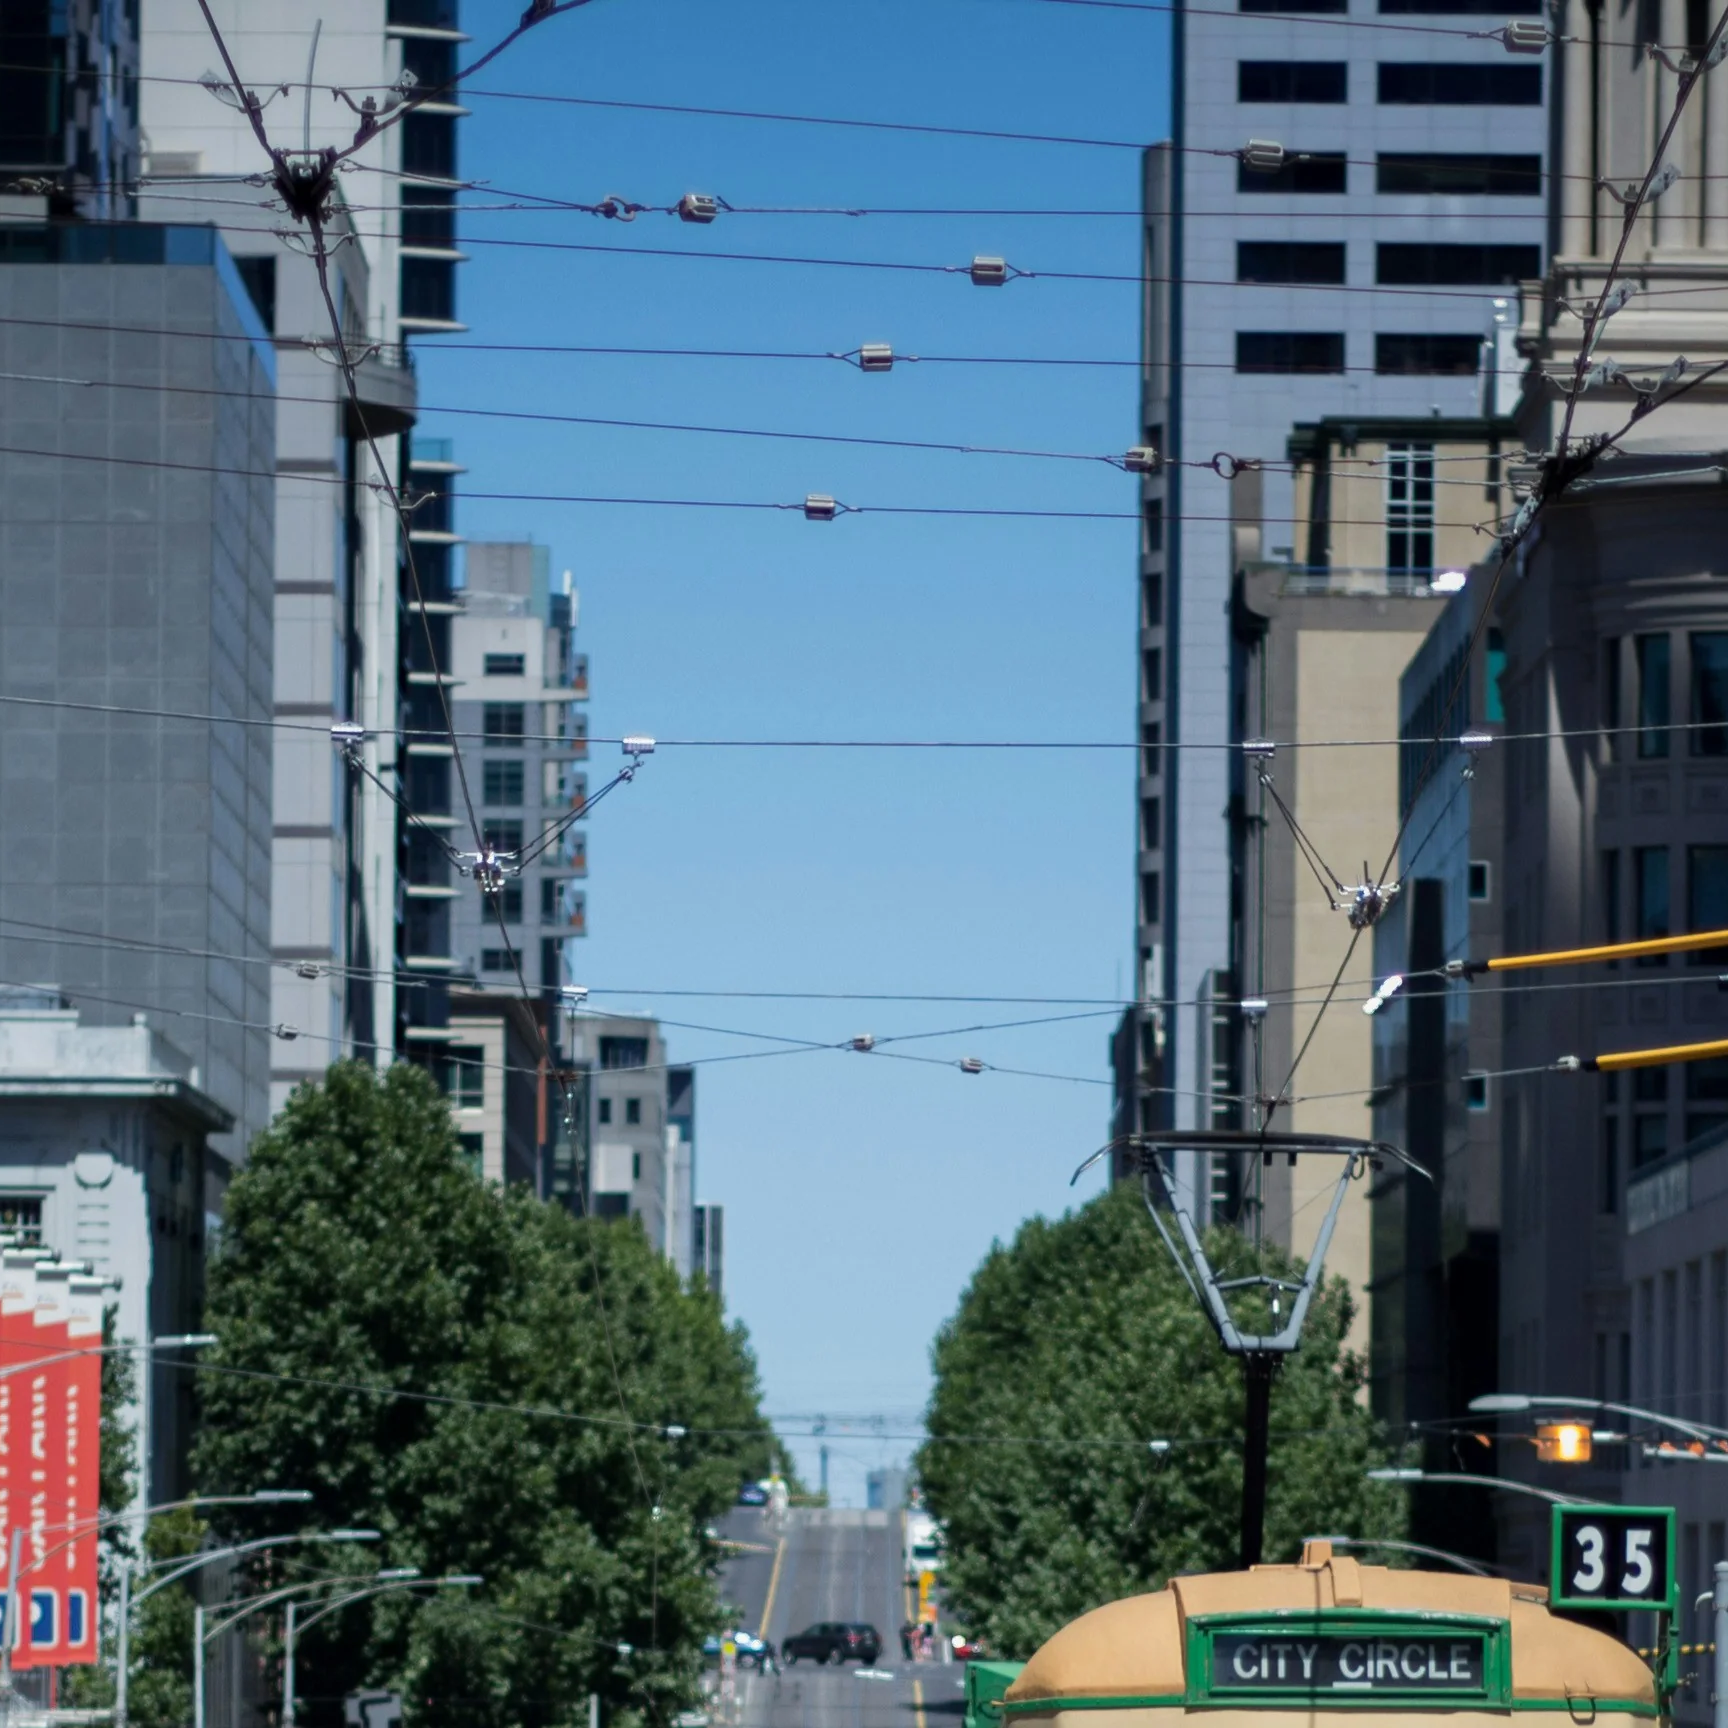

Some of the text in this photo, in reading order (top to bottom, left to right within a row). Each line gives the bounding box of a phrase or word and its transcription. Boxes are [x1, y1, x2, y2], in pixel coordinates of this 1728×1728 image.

[1573, 1525, 1652, 1594] 35
[1233, 1643, 1471, 1679] CITY CIRCLE
